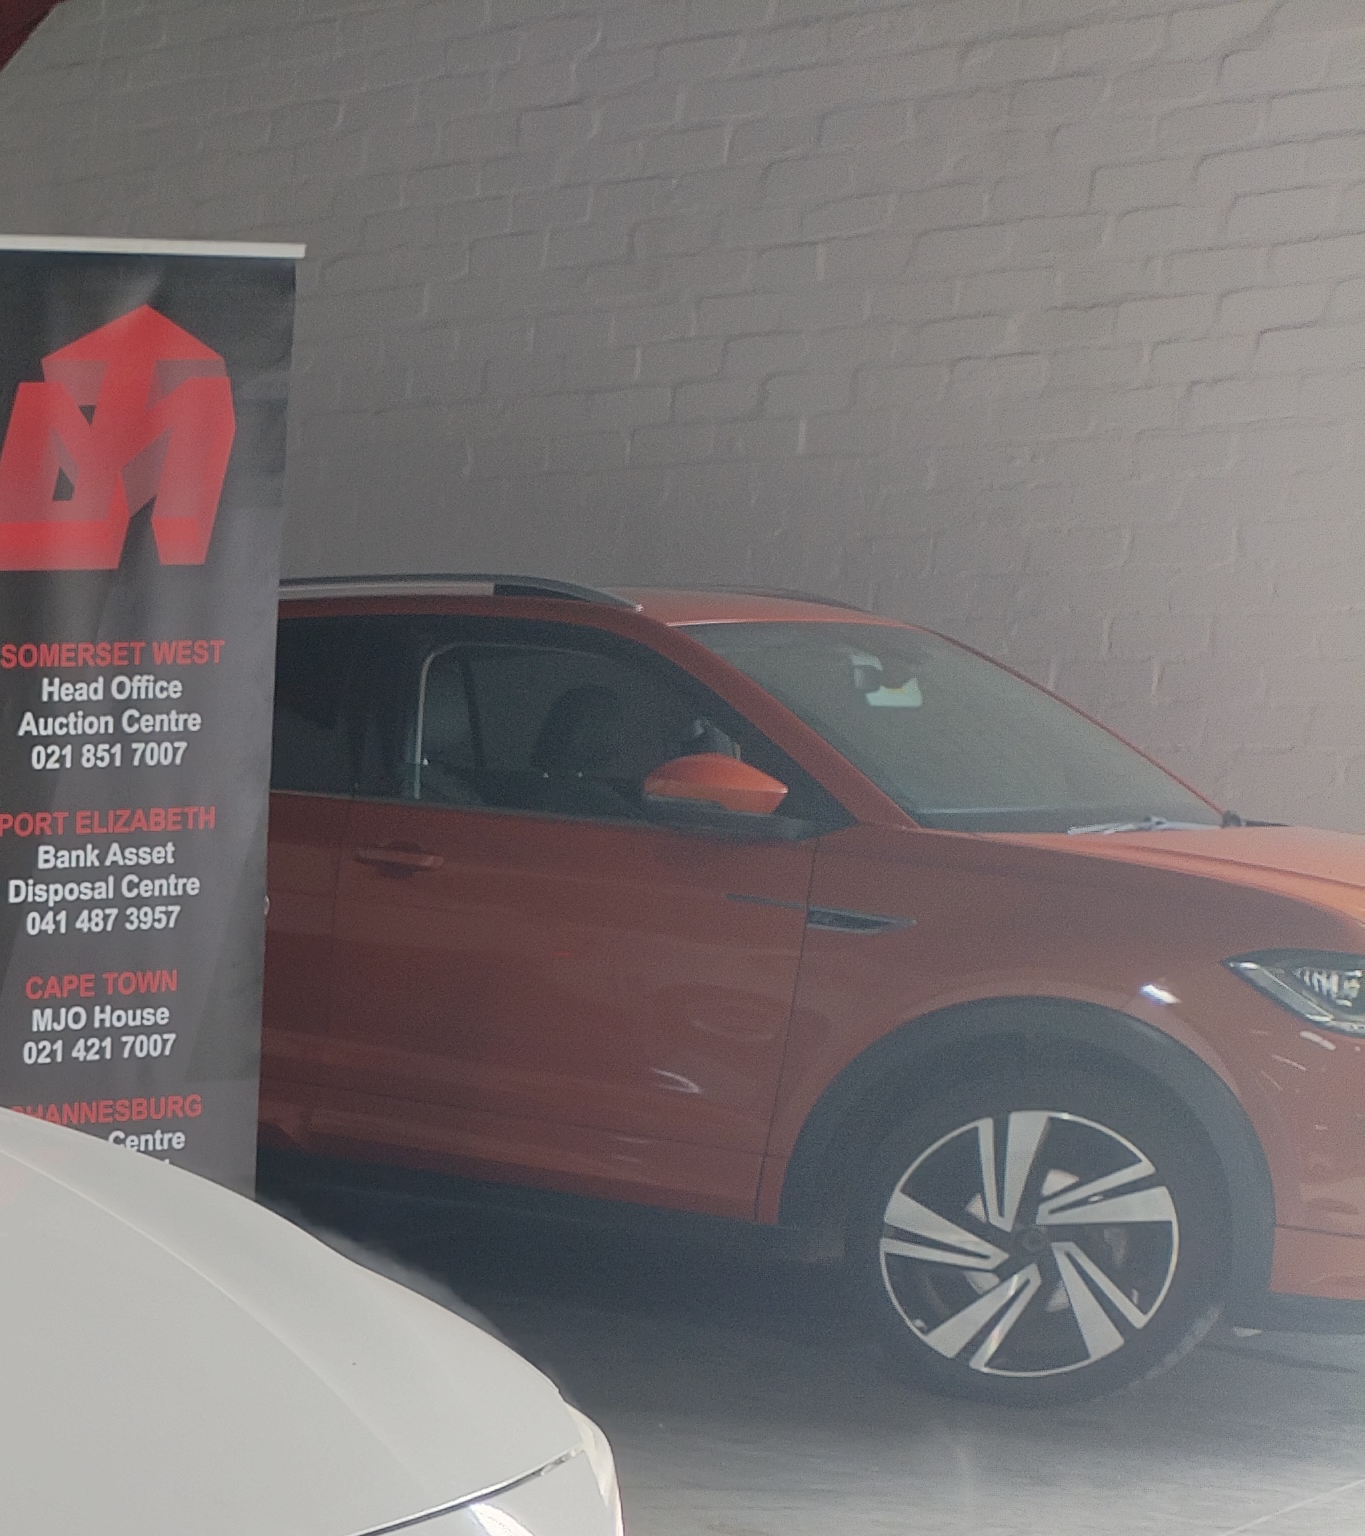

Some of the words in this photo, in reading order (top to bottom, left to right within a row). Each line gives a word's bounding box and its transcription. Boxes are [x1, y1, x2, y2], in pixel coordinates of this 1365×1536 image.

[0, 641, 146, 669] SOMERSET
[152, 640, 226, 665] WEST
[41, 676, 104, 702] Head
[111, 674, 183, 699] Office
[17, 711, 114, 736] Auction
[121, 709, 202, 733] Centre
[31, 744, 72, 770] 021
[81, 742, 121, 768] 851
[131, 741, 188, 766] 7007
[75, 805, 216, 835] ELIZABETH
[37, 843, 99, 869] Bank
[104, 841, 175, 866] Asset
[8, 875, 114, 907] Disposal
[121, 873, 200, 898] Centre
[26, 910, 67, 935] 041
[75, 908, 118, 932] 487
[125, 905, 181, 931] 3957
[25, 973, 95, 999] CAPE
[103, 969, 177, 996] TOWN
[31, 1006, 87, 1031] MJO
[94, 1004, 170, 1028] House
[23, 1039, 63, 1064] 021
[71, 1037, 112, 1061] 421
[121, 1033, 176, 1058] 7007
[11, 1093, 203, 1125] HANNESBURG
